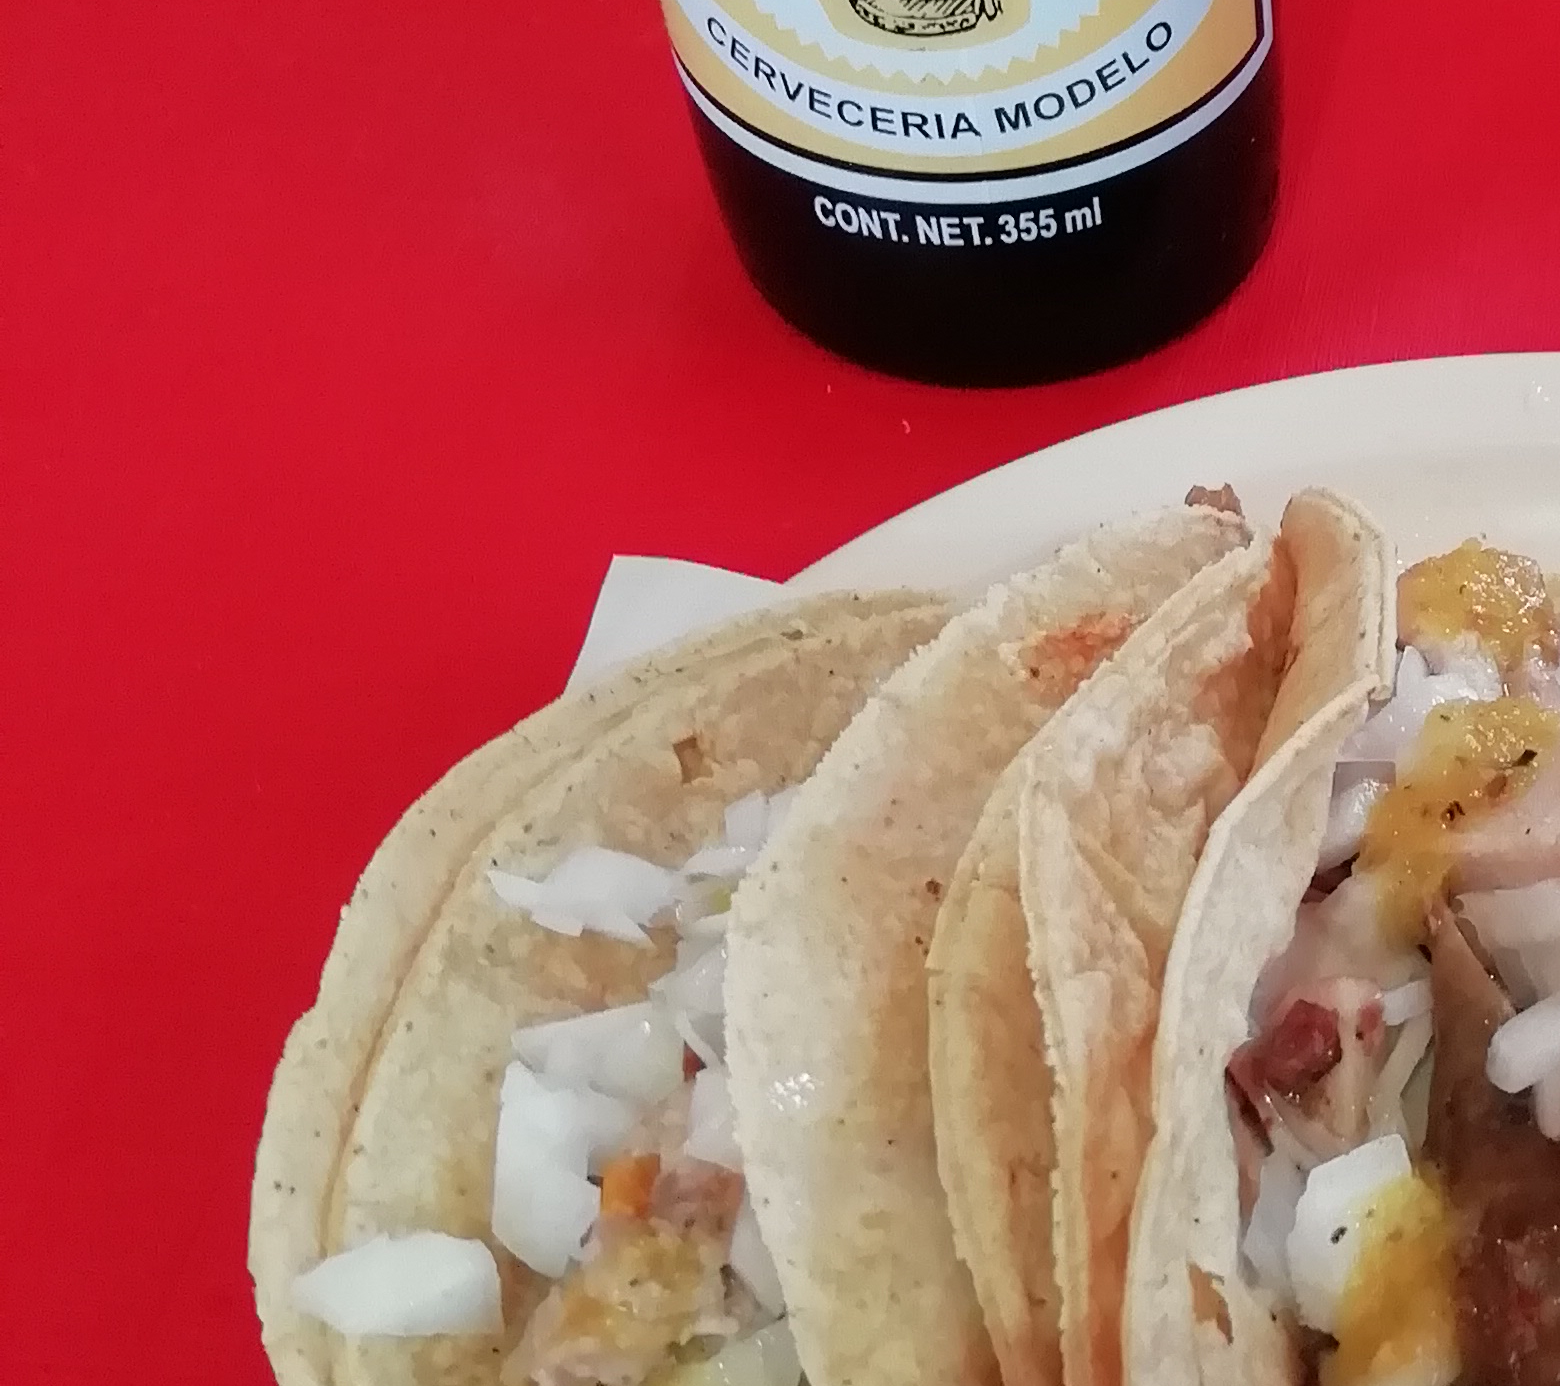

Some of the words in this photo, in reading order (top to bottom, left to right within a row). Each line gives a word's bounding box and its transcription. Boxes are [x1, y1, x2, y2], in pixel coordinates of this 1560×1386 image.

[706, 15, 983, 141] CERVECERIA
[994, 20, 1174, 134] MODELO
[813, 195, 910, 243] CONT.
[916, 215, 994, 247] NET.
[998, 207, 1058, 245] 355
[1065, 196, 1103, 235] ml
